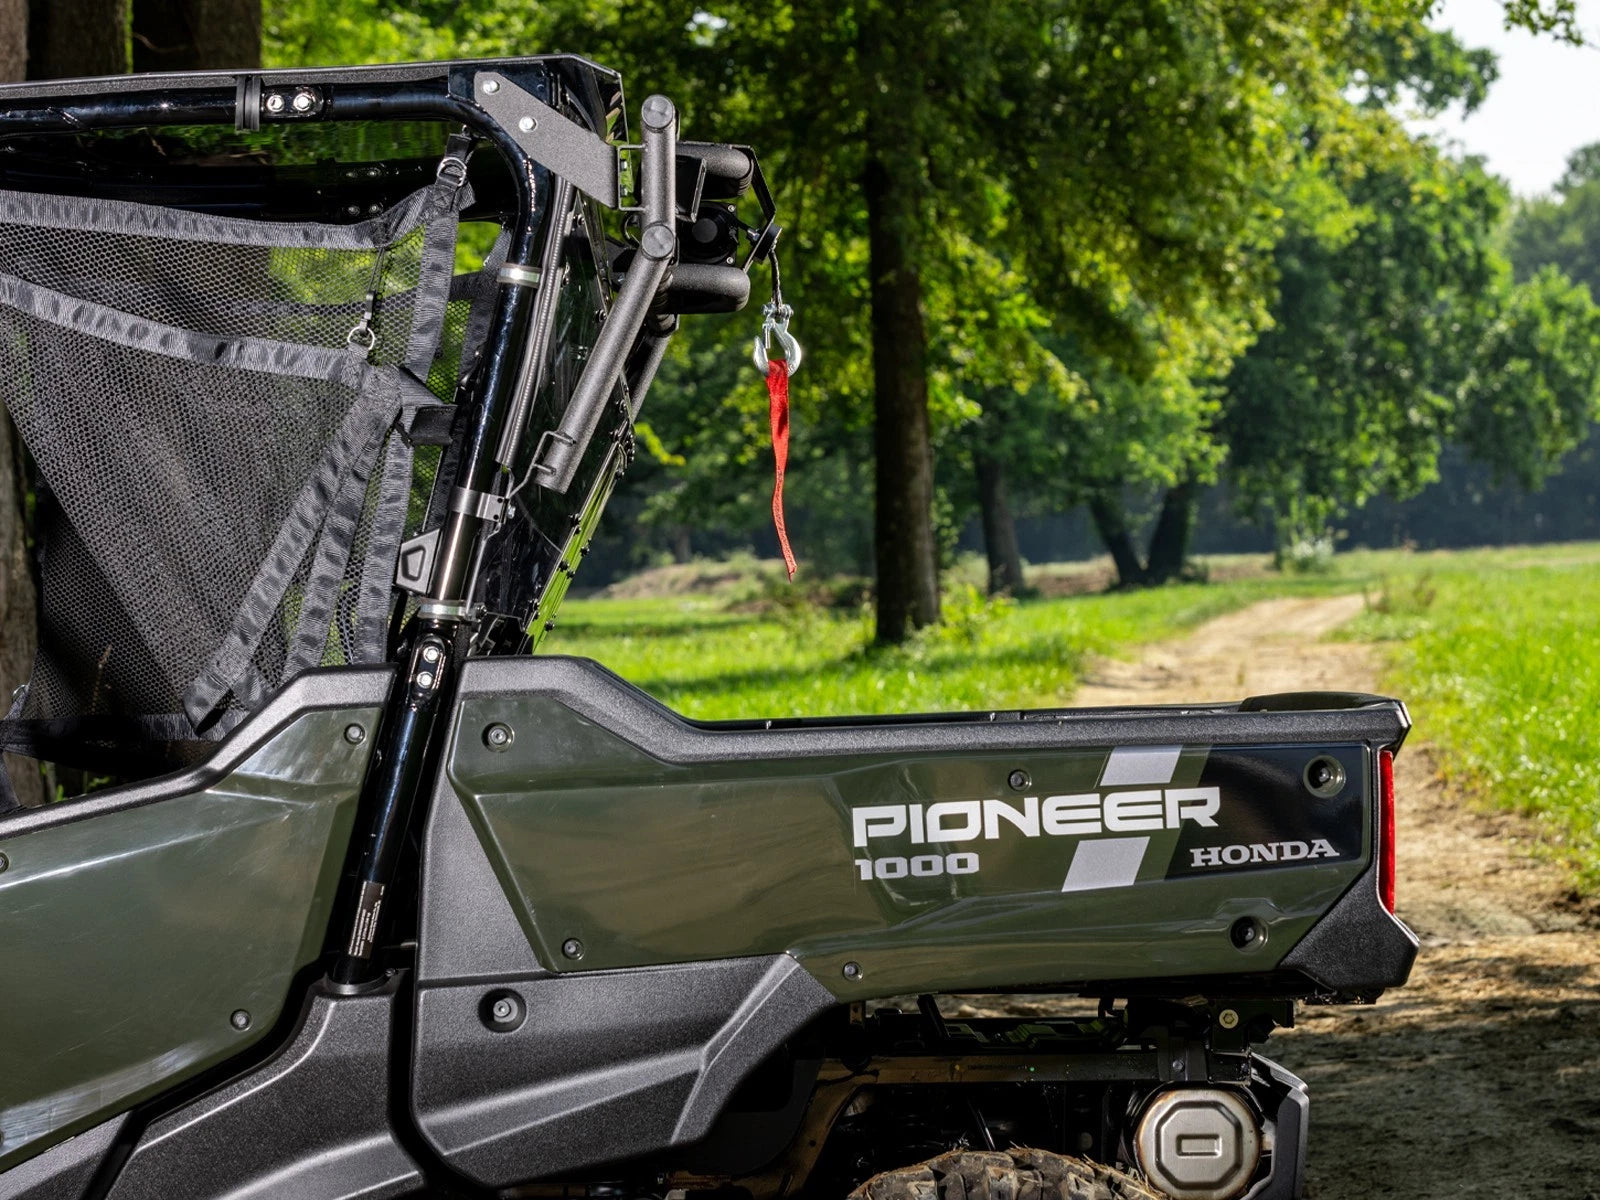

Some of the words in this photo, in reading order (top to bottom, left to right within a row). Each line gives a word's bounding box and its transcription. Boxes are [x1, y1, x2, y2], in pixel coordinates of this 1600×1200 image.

[852, 786, 1221, 847] PIONEER
[854, 852, 980, 881] 1000
[1190, 838, 1340, 867] HONDA
